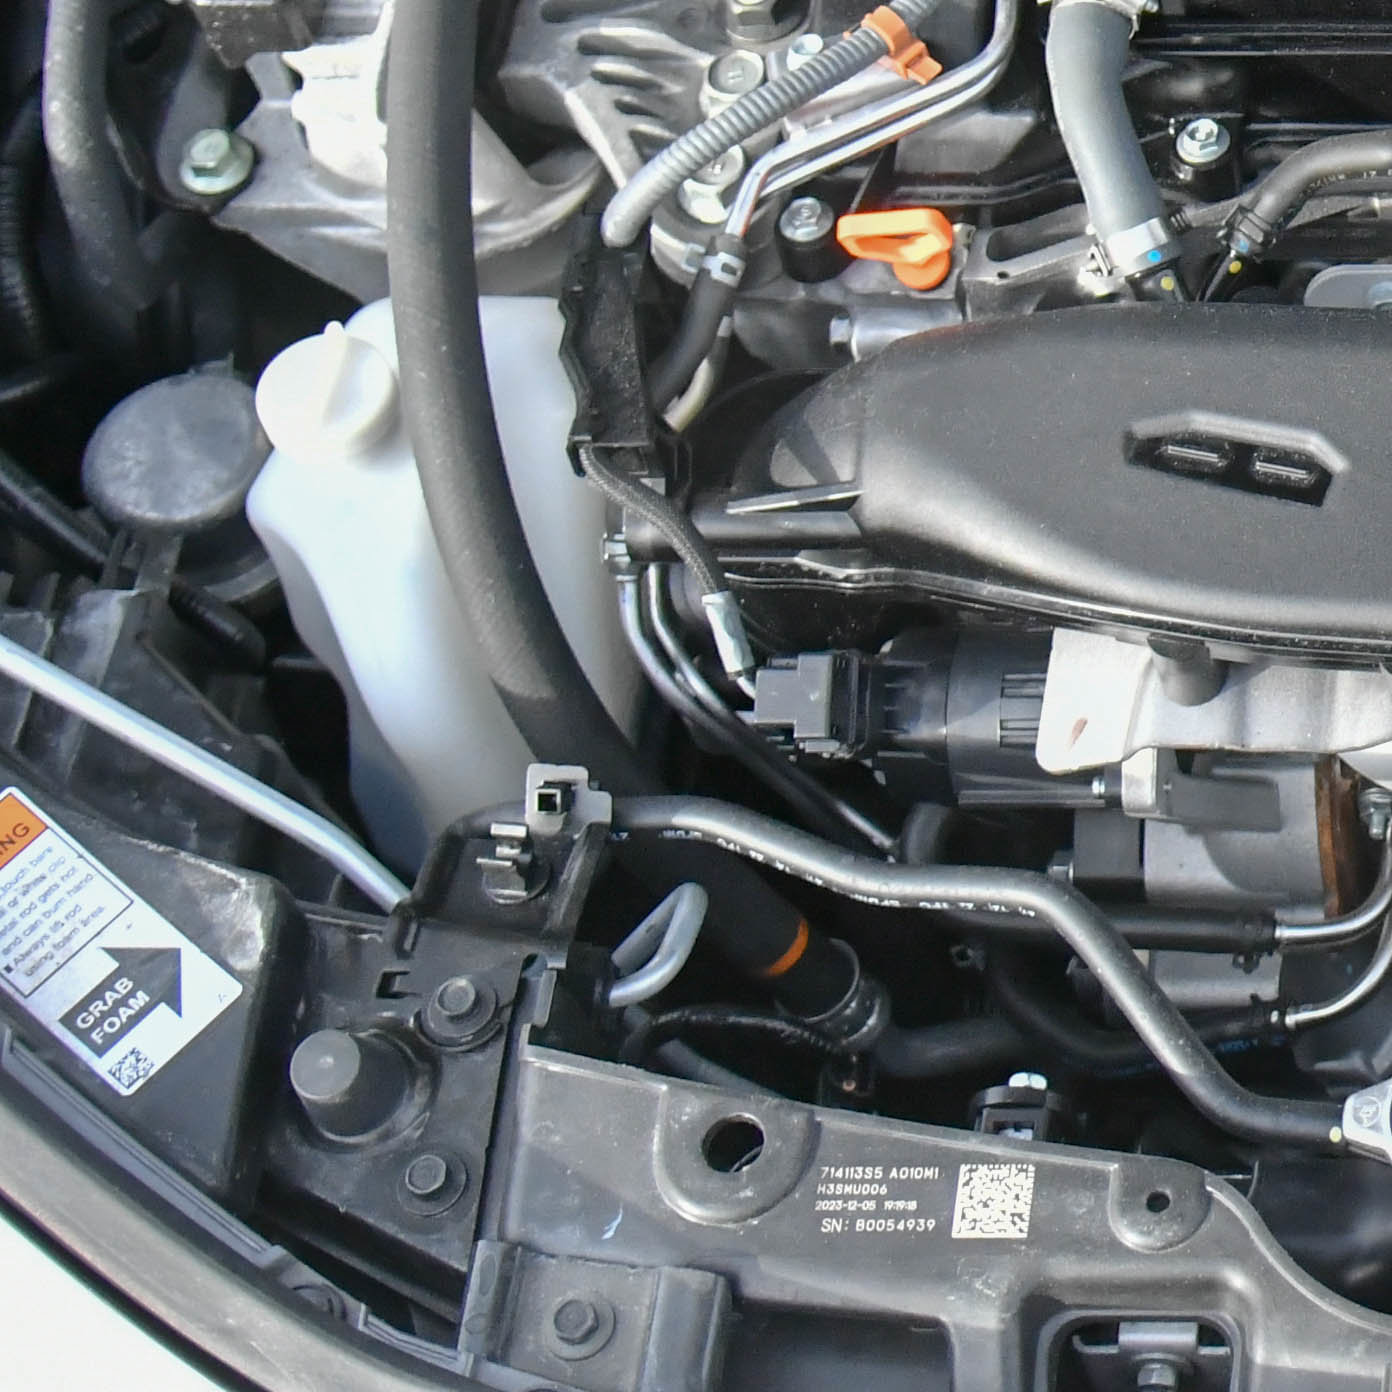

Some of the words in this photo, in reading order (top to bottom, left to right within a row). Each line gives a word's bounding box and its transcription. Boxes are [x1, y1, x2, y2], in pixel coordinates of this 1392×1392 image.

[75, 976, 135, 1030] GRAB
[90, 989, 151, 1046] FOAM
[889, 1166, 940, 1180] A010M1
[816, 1183, 888, 1196] H3SMU006
[814, 1199, 877, 1212] 2023-12-05
[820, 1217, 850, 1234] SN:
[855, 1218, 937, 1232] B0054939
